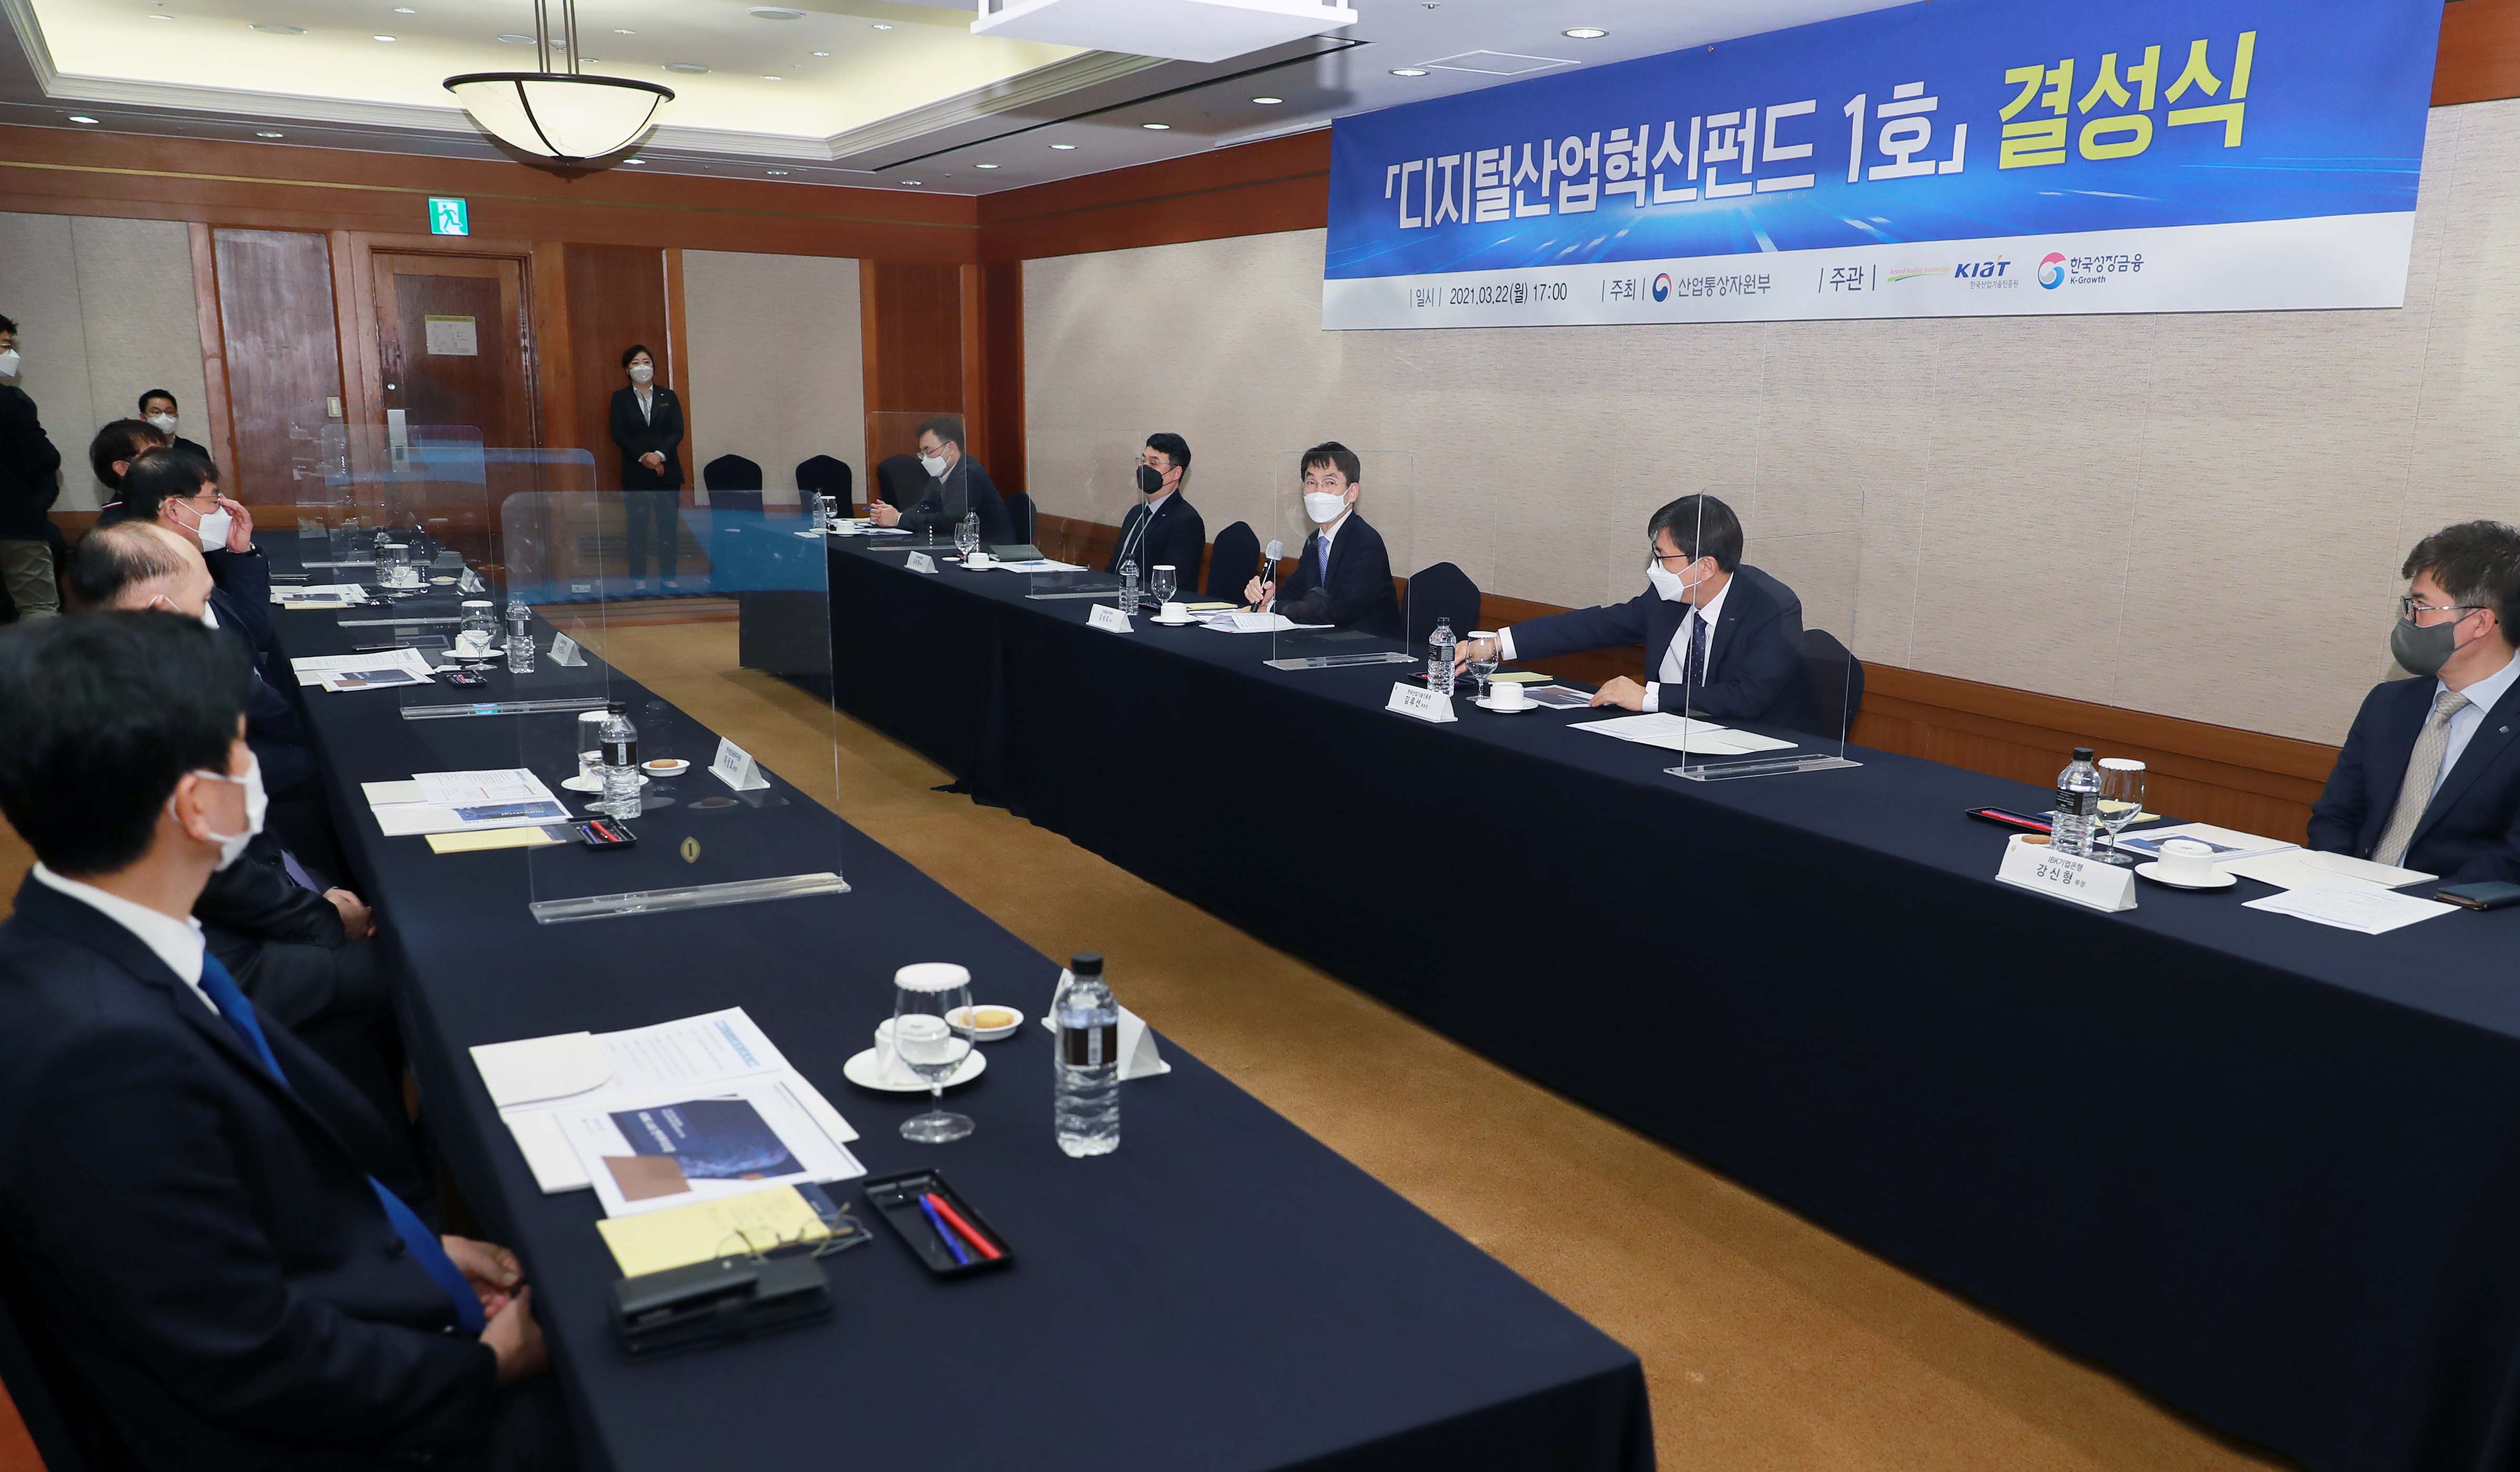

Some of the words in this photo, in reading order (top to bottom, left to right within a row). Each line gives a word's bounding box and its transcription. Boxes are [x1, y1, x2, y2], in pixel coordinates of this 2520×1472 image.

[1999, 30, 2256, 171] 결성식
[2071, 254, 2144, 274] 한국성장금융
[1610, 278, 1636, 302] 주최
[1678, 274, 1771, 297] 산업통상자원부
[1829, 265, 1864, 292] 주관
[1970, 279, 2019, 289] 한국산업기술진흥원
[2070, 275, 2105, 284] K-Growth
[1450, 282, 1528, 305] 2021.03.22(월)
[1533, 282, 1568, 302] 17:00
[2048, 856, 2084, 872] IBK기업은행
